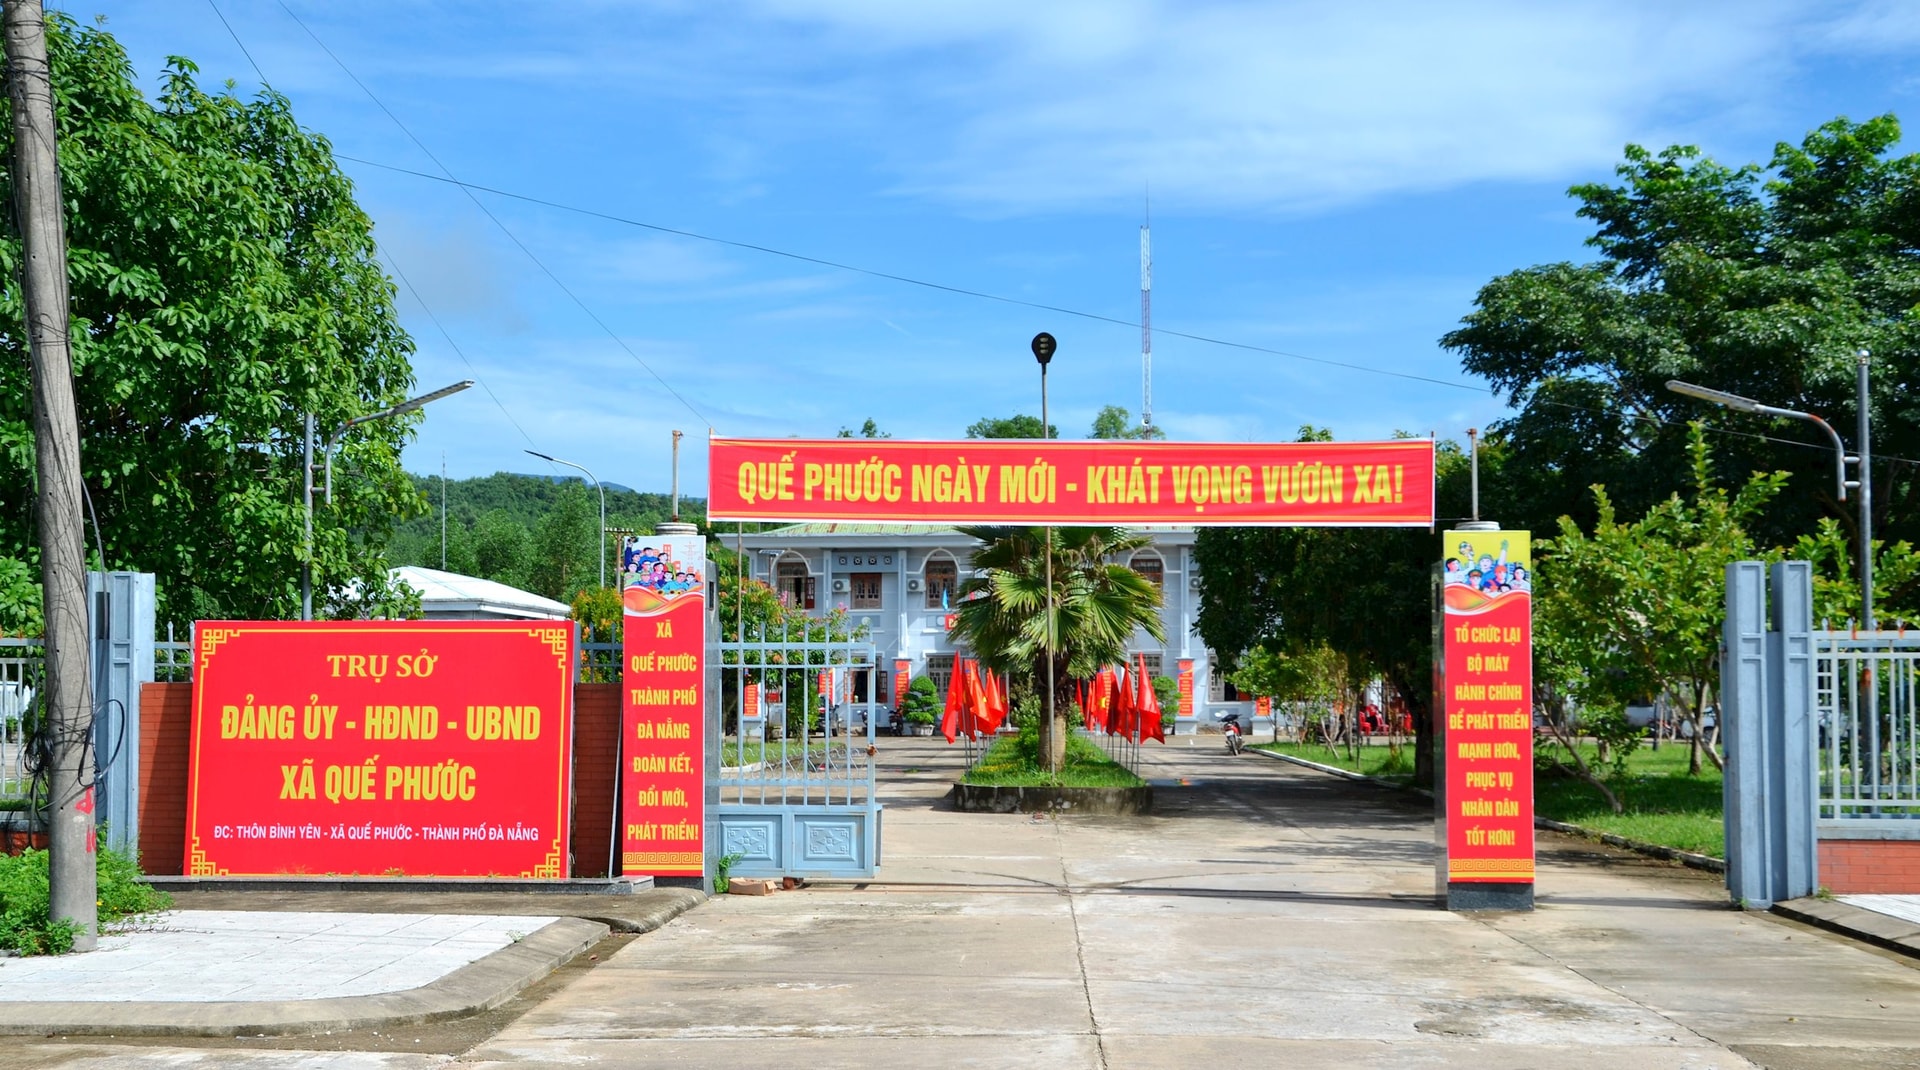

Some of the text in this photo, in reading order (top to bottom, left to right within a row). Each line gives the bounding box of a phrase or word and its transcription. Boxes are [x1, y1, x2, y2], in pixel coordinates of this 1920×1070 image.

[738, 451, 1403, 512] QUẾ PHƯỚC NGÀY MỚI - KHÁT VỌNG VƯƠN XA!
[656, 619, 672, 638] XÃ
[1455, 622, 1521, 646] TỔ CHỨC LẠI
[327, 648, 438, 683] TRỤ SỞ
[632, 651, 696, 673] QUẾ PHƯỚC
[1467, 653, 1509, 675] BỘ MÁY
[631, 684, 696, 705] THÀNH PHỐ
[1455, 682, 1522, 700] HÀNH CHÍNH
[221, 694, 295, 739] ĐẢNG
[304, 694, 338, 739] ỦY
[365, 706, 438, 740] HĐND
[466, 706, 540, 740] UBND
[1449, 708, 1529, 729] ĐỂ PHÁT TRIỂN
[637, 718, 690, 739] ĐÀ NẴNG
[1458, 742, 1520, 761] MẠNH HƠN,
[633, 752, 693, 774] ĐOÀN KẾT,
[280, 755, 476, 804] XÃ QUẾ PHƯỚC
[1466, 772, 1513, 790] PHỤC VỤ
[639, 785, 688, 808] ĐỔI MỚI,
[1462, 798, 1519, 816] NHÂN DÂN
[214, 826, 233, 838] ĐC:
[237, 823, 266, 838] THÔN
[270, 823, 295, 838] BÌNH
[299, 823, 320, 838] YÊN
[331, 824, 345, 839] XÃ
[348, 822, 371, 839] QUẾ
[374, 824, 412, 840] PHƯỚC
[422, 824, 459, 840] THÀNH
[463, 822, 486, 840] PHỐ
[489, 824, 504, 840] ĐÀ
[507, 822, 538, 840] NẴNG
[627, 818, 698, 840] PHÁT TRIỂN!
[1466, 825, 1515, 845] TỐT HƠN!
